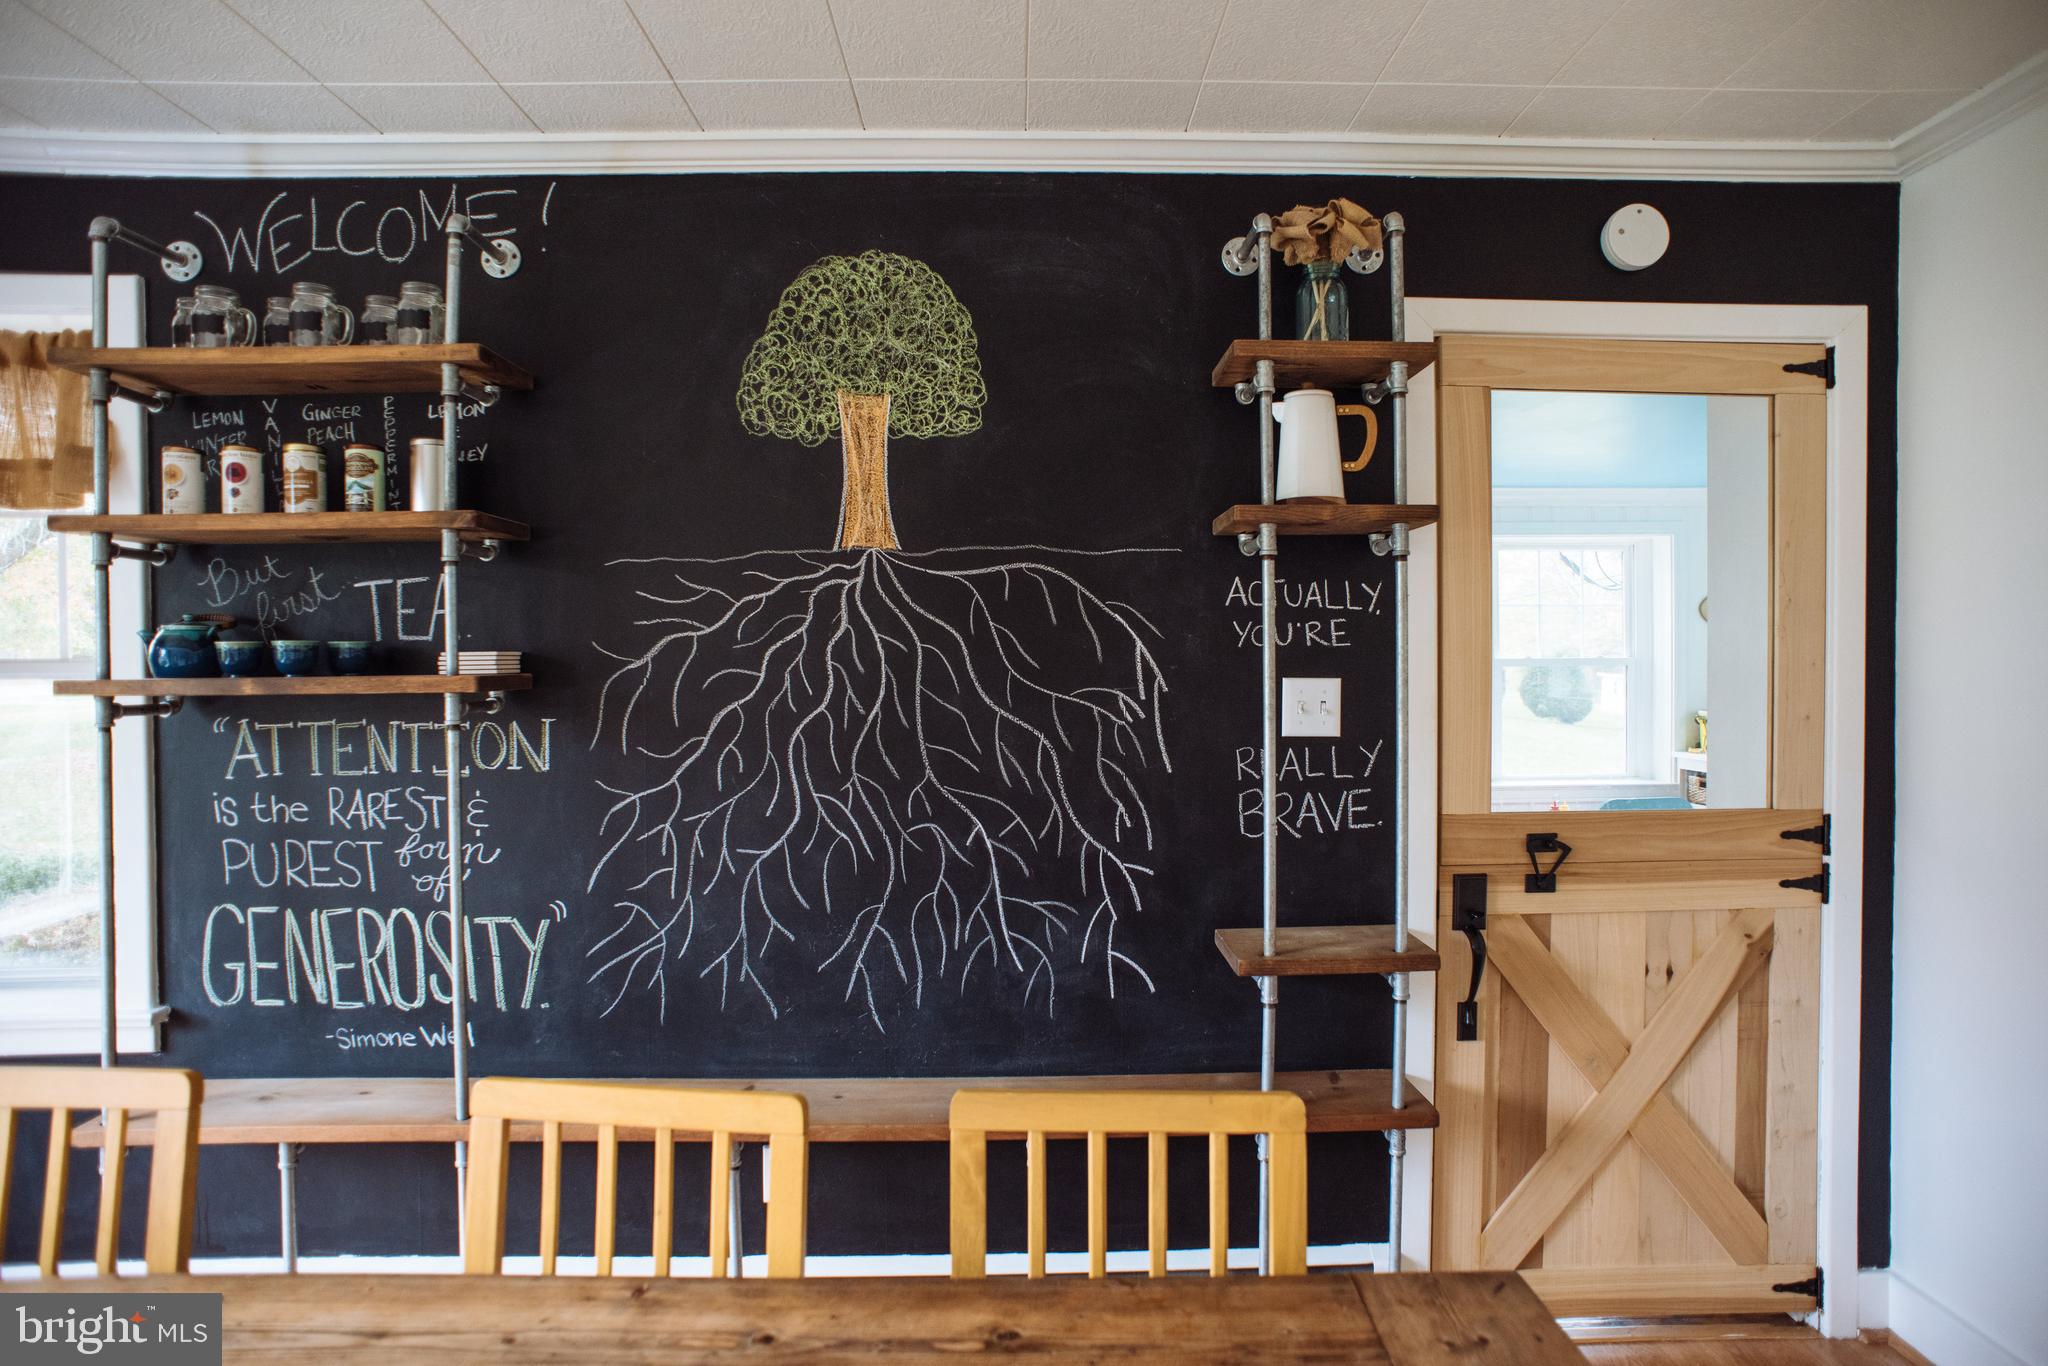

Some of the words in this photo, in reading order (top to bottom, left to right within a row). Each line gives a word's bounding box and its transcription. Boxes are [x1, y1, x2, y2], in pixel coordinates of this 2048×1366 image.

[192, 409, 244, 429] LEMON
[302, 403, 362, 422] GINGER
[307, 421, 356, 446] PEACH
[383, 395, 401, 512] PEPPERMINT
[198, 556, 292, 608] But
[252, 566, 342, 648] first
[212, 791, 240, 827] is
[250, 791, 310, 824] the
[328, 786, 447, 832] RAREST
[221, 838, 383, 892] PUREST
[418, 1021, 476, 1048] Wel
